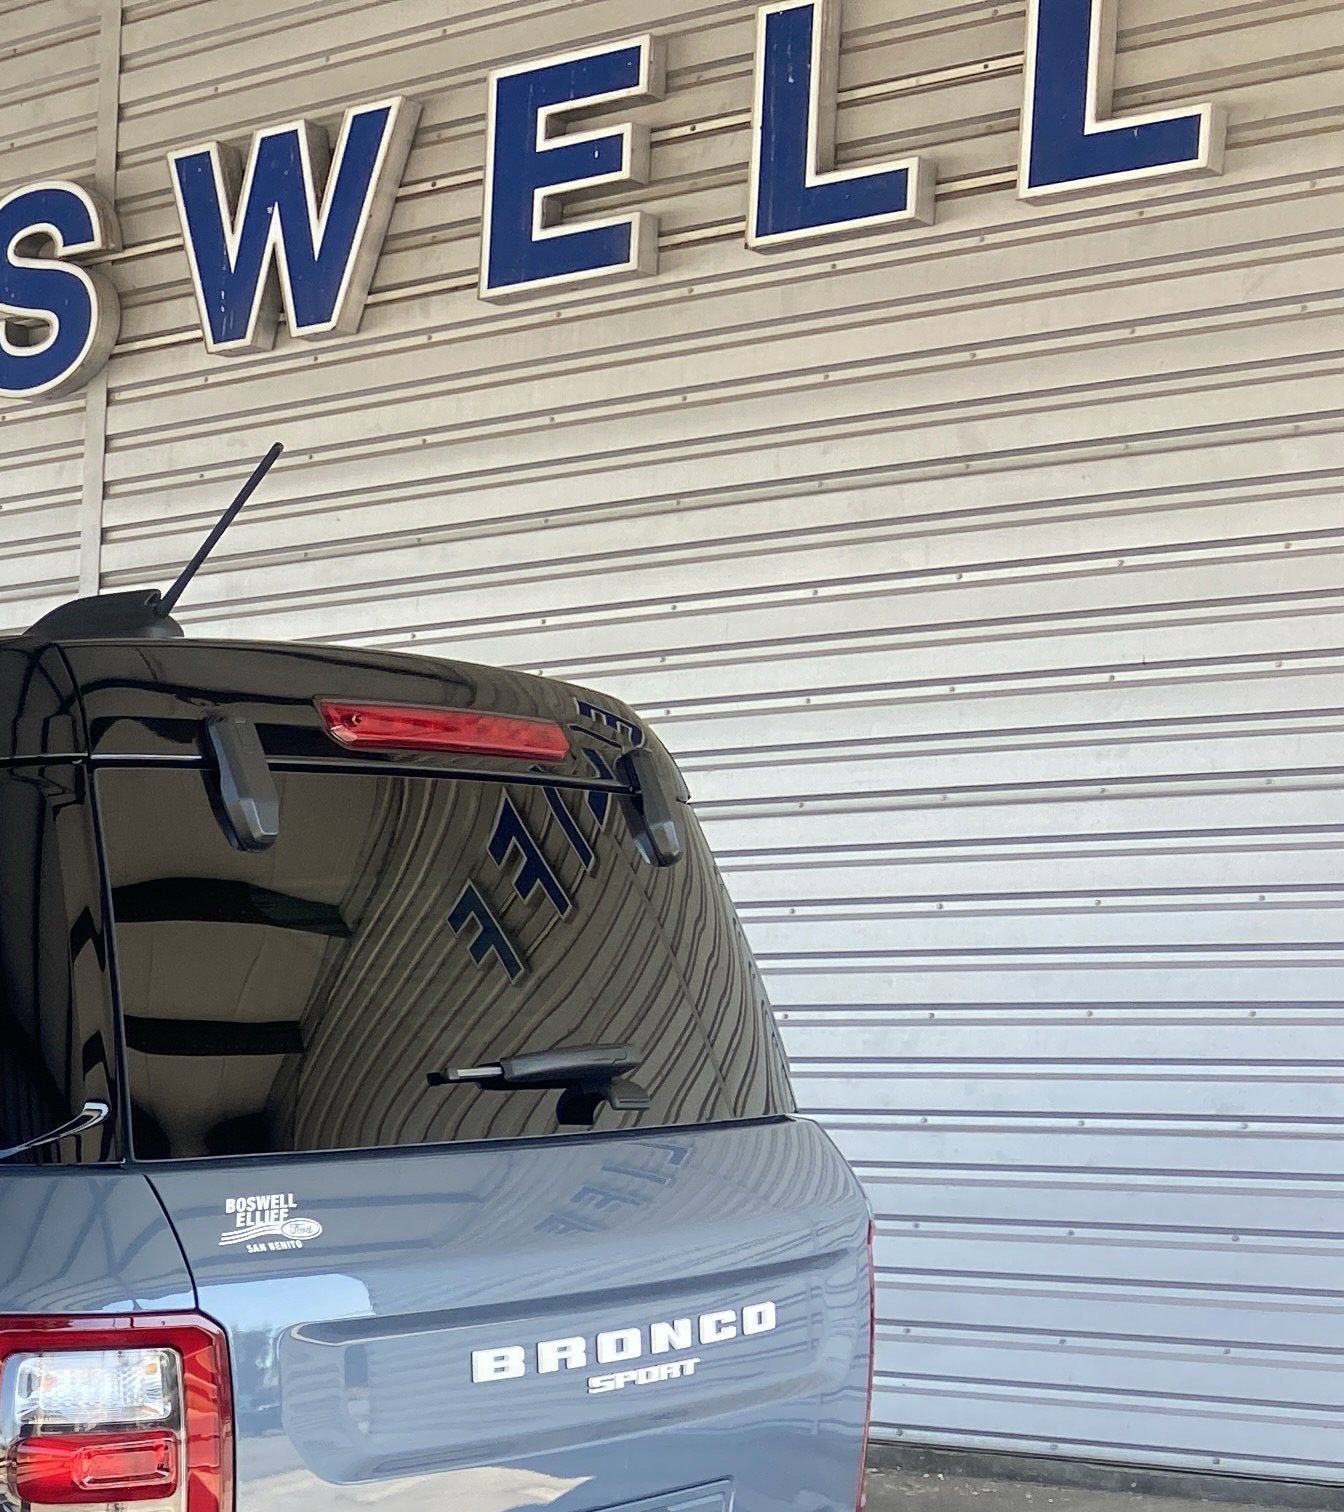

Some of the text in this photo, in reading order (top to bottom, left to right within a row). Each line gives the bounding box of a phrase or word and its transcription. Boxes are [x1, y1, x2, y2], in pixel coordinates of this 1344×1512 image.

[225, 1192, 298, 1214] BOSWELL
[235, 1208, 289, 1228] ELLIFF
[246, 1239, 303, 1253] SAN BENITO
[471, 1301, 777, 1384] BRONCO
[586, 1357, 701, 1394] SPORT
